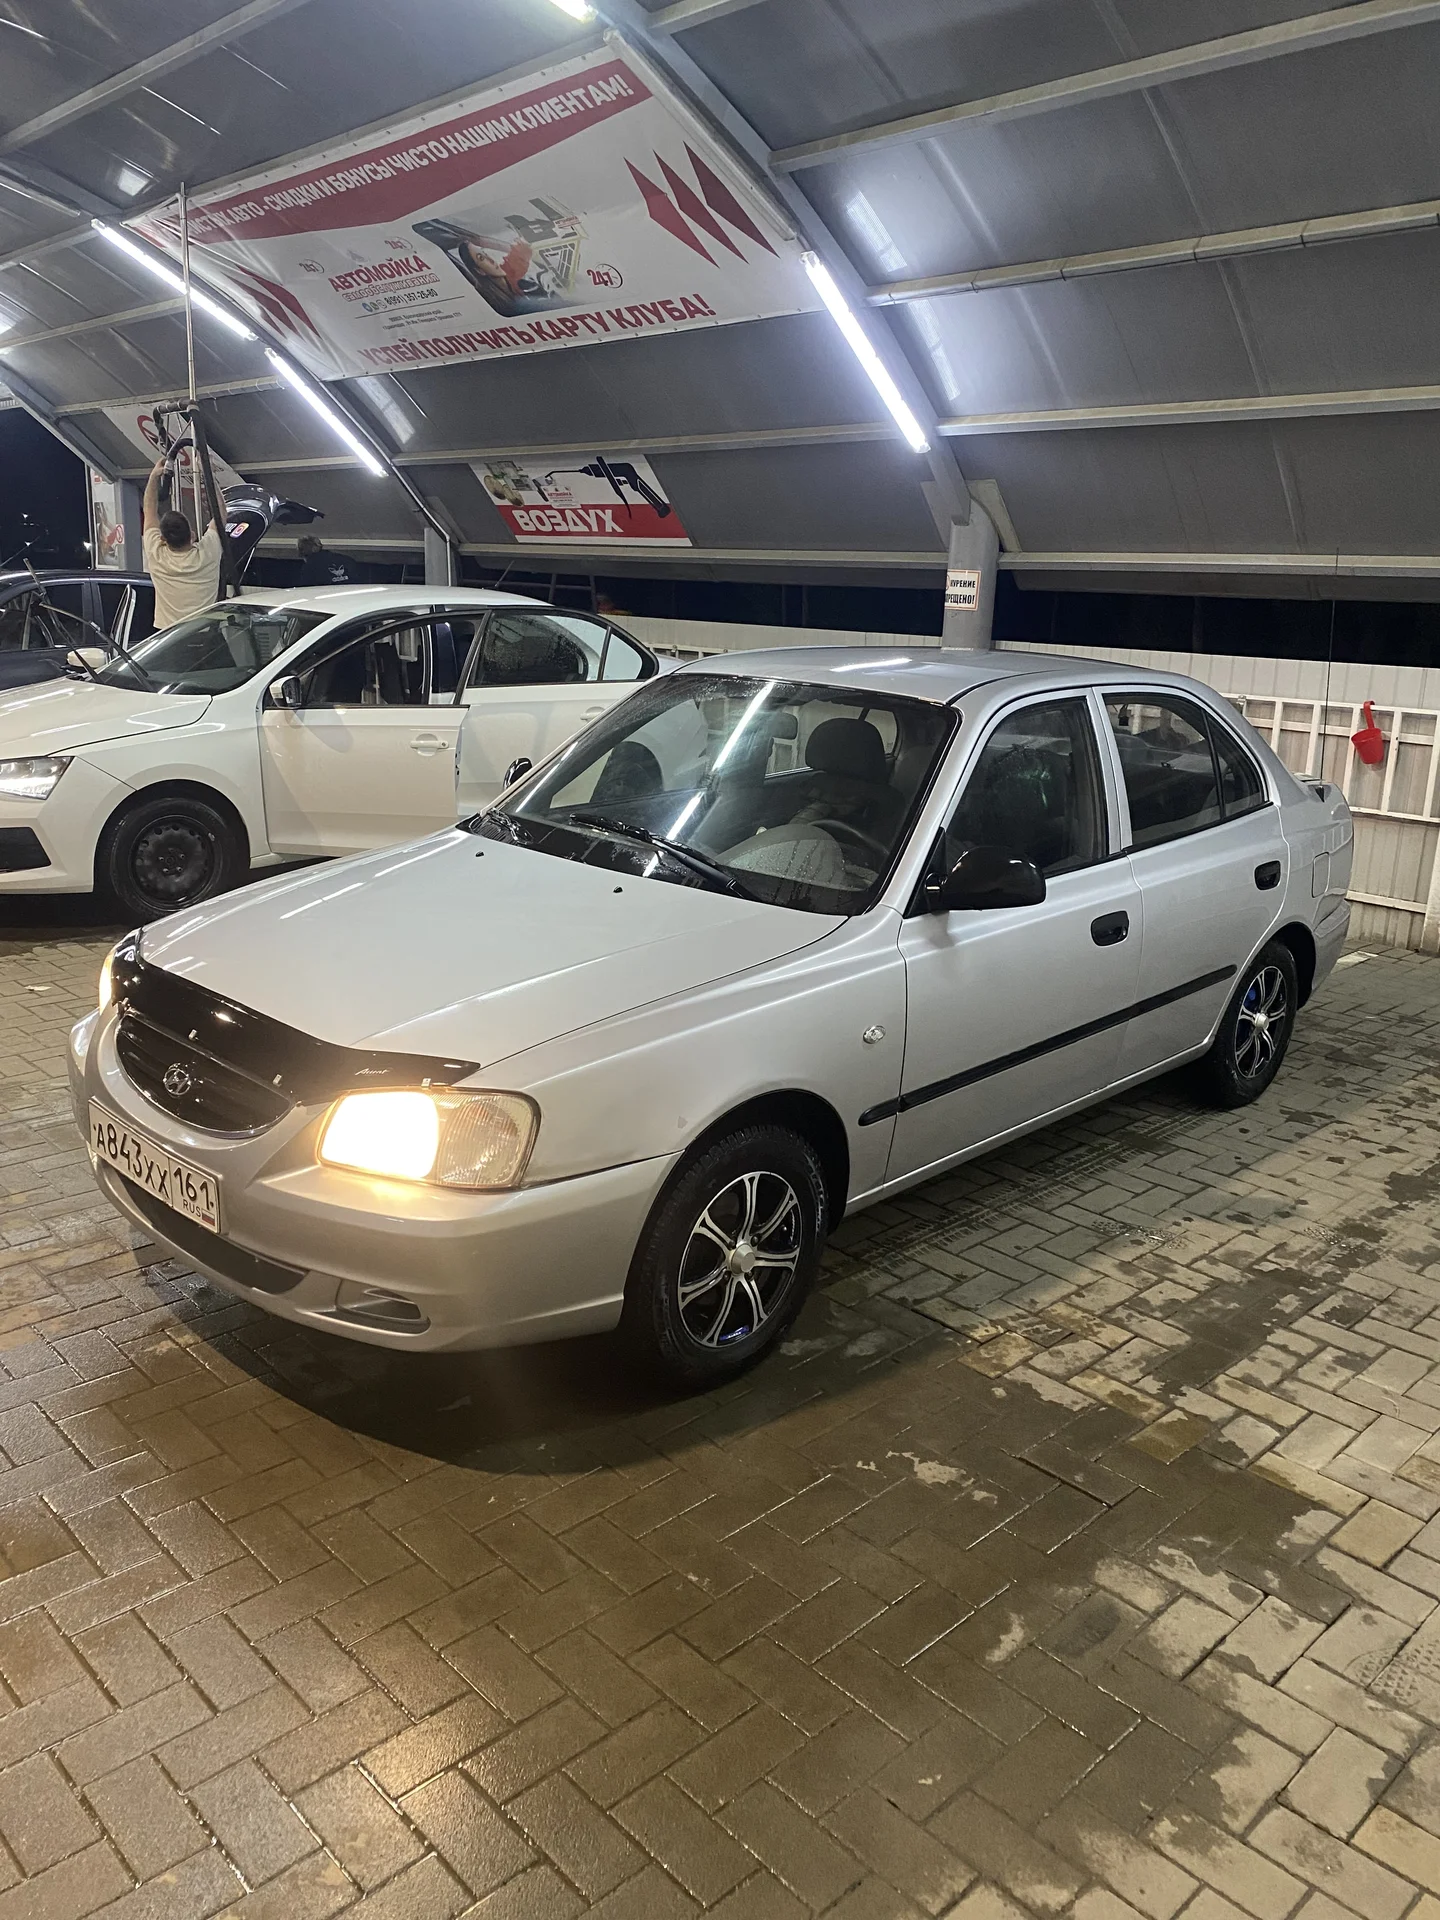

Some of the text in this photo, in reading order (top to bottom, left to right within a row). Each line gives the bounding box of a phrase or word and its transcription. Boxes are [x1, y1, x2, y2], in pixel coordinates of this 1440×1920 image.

[508, 74, 635, 132] КЛИЕНТАМ!
[440, 116, 519, 155] НАШИМ
[386, 140, 449, 172] ЧИСТО
[314, 178, 337, 197] И
[325, 159, 397, 192] БОНУСЫ
[263, 182, 326, 211] СКИДКИ
[187, 209, 235, 235] ИСТЫХ
[229, 201, 265, 225] АВТО
[328, 254, 431, 292] АВТОМОЙКА
[357, 293, 717, 366] УСПЕЙ ПОЛУЧИТЬ КАРТУ КЛУБА!
[511, 509, 625, 533] ВОЗДУХ
[96, 1122, 210, 1211] А843ХХ 161
[182, 1198, 201, 1218] RUS
